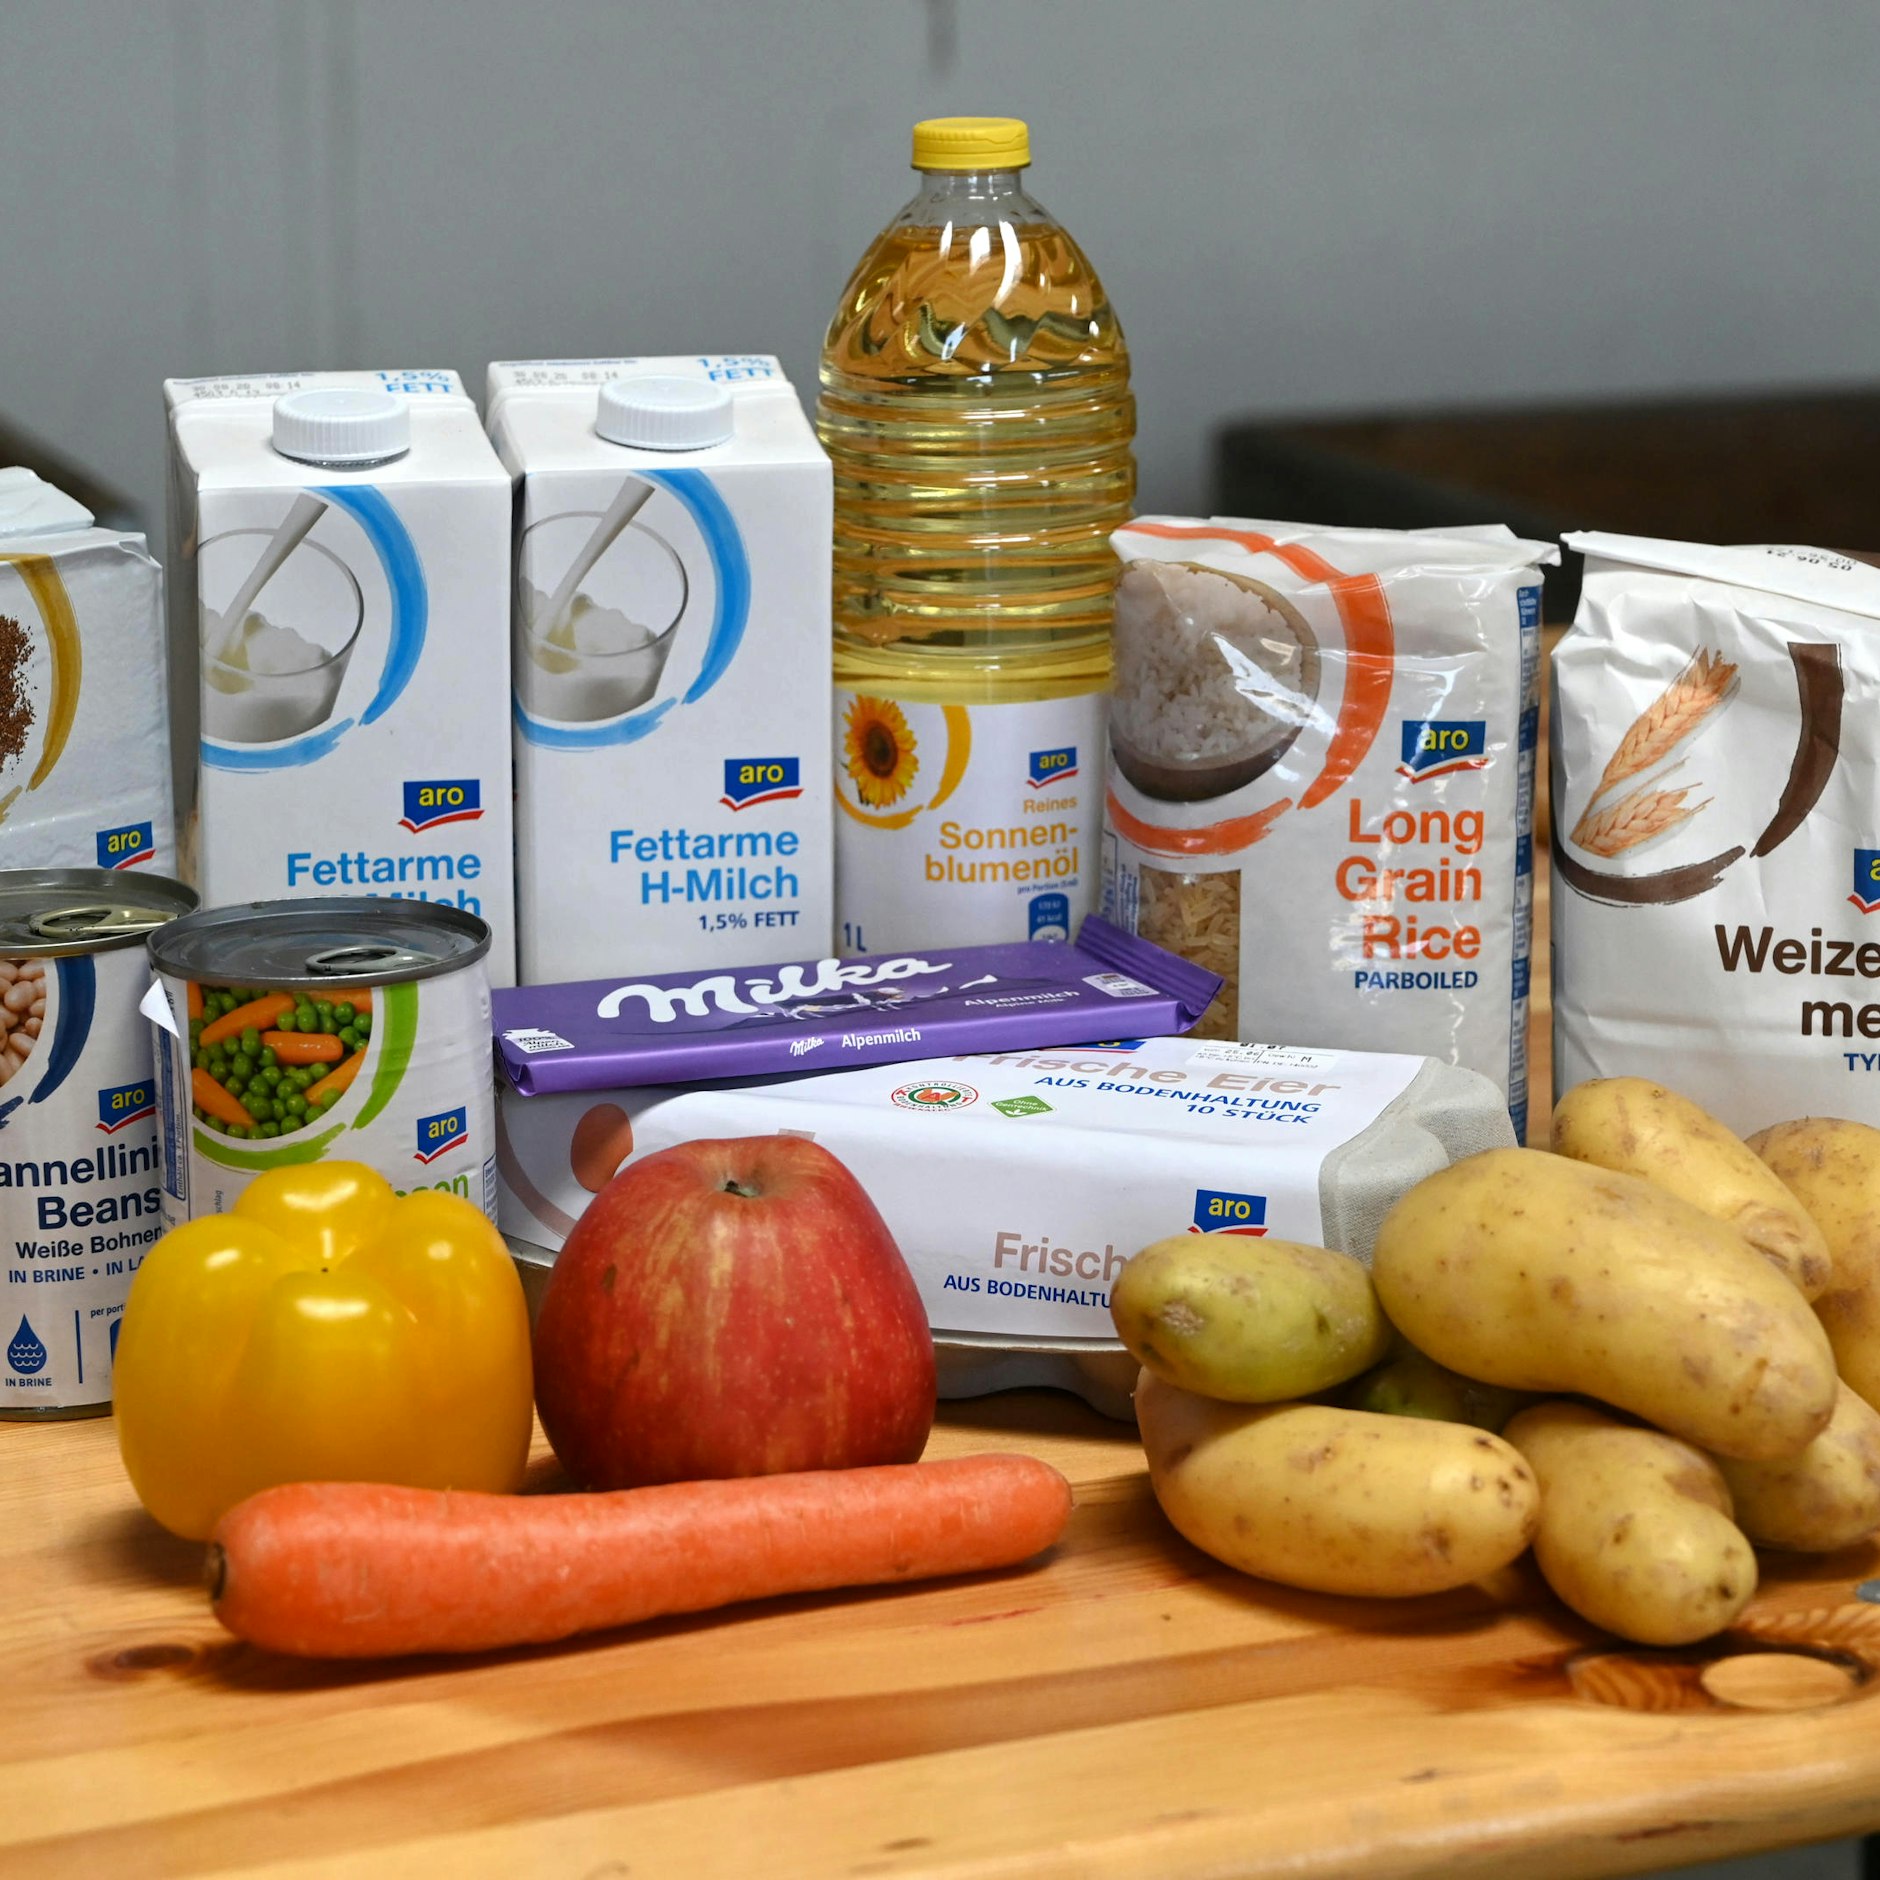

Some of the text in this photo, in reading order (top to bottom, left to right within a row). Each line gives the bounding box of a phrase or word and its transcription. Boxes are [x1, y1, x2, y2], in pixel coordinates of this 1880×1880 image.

[1421, 728, 1469, 750] aro
[738, 764, 784, 784] aro
[1039, 752, 1068, 769] aro
[418, 786, 464, 806] aro
[1023, 796, 1078, 814] Reines
[938, 820, 1079, 849] Sonnen-
[1349, 798, 1484, 855] Long
[107, 830, 142, 853] aro
[610, 828, 799, 864] Fettarme
[287, 852, 482, 887] Fettarme
[925, 846, 1079, 883] blumenöl
[641, 865, 798, 905] H-Milch
[1335, 855, 1482, 902] Grain
[699, 911, 800, 932] 1,5% FETT
[1362, 914, 1481, 960] Rice
[1714, 924, 1880, 979] Weize
[597, 958, 952, 1023] Milka
[1354, 970, 1478, 989] PARBOILED
[1801, 1001, 1880, 1039] me
[789, 1027, 921, 1056] Milka Alpenmilch
[111, 1086, 145, 1110] aro
[1035, 1076, 1322, 1113] AUS BODENHALTUNG
[1206, 1072, 1341, 1097] Eier
[1187, 1103, 1313, 1125] 10 STÜCK
[428, 1116, 458, 1140] aro
[0, 1135, 159, 1187] annellini
[37, 1187, 161, 1230] Beans
[1208, 1196, 1251, 1219] aro
[15, 1240, 83, 1259] Weiße
[994, 1231, 1128, 1281] Frisch
[9, 1270, 26, 1283] IN
[33, 1266, 85, 1283] BRINE
[106, 1260, 123, 1275] IN
[943, 1274, 1111, 1309] AUS BODENHALTU
[91, 1303, 125, 1319] per port
[5, 1377, 52, 1387] IN BRINE
